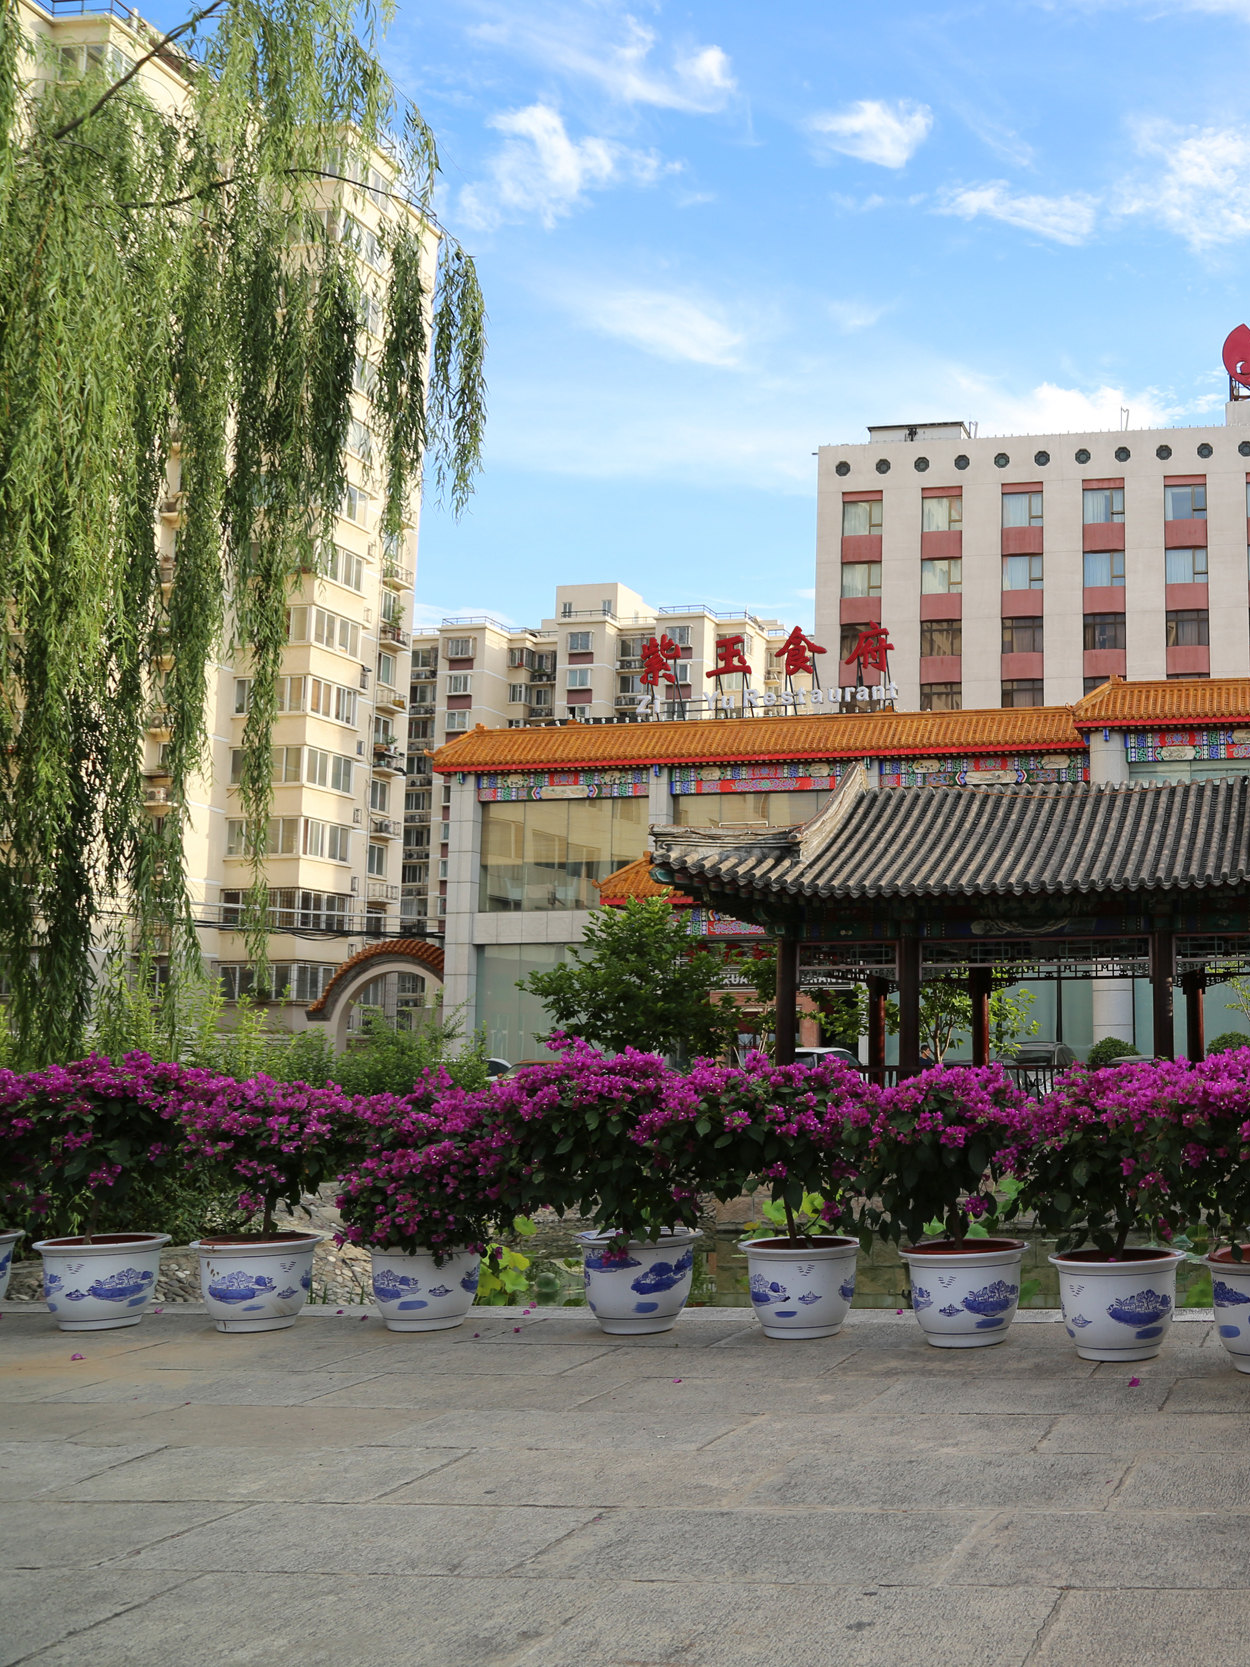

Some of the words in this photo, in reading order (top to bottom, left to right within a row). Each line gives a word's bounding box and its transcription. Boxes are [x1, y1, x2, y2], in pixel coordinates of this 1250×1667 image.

[640, 620, 895, 686] 紫玉食府
[703, 691, 735, 710] Yu
[743, 681, 899, 708] Restaurant
